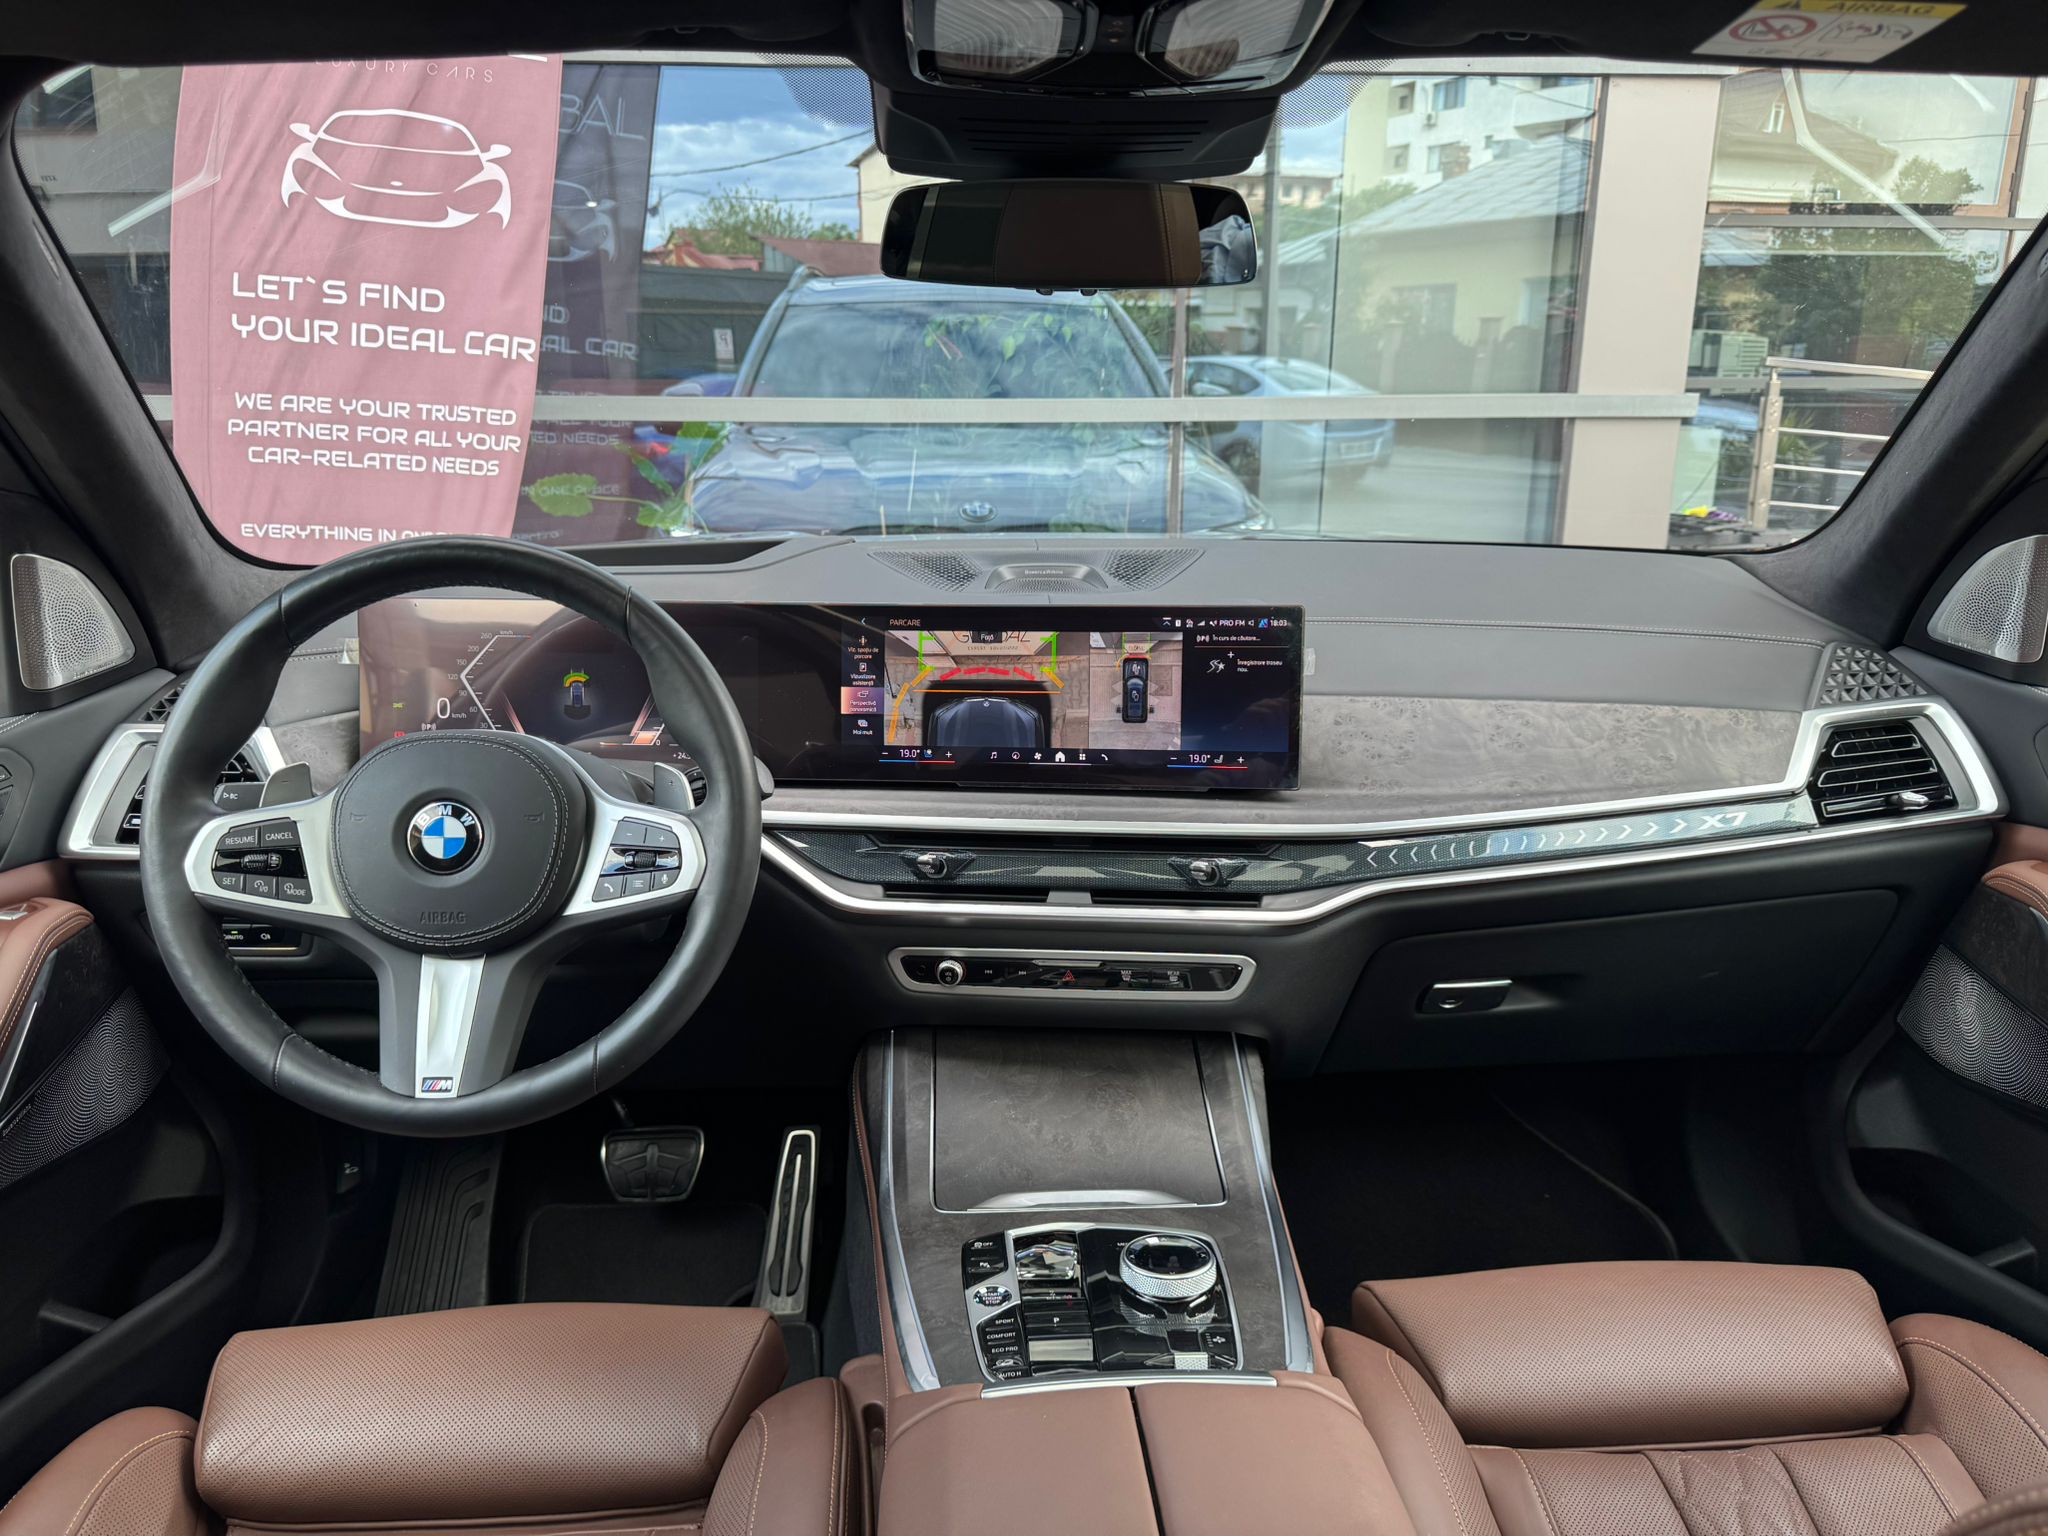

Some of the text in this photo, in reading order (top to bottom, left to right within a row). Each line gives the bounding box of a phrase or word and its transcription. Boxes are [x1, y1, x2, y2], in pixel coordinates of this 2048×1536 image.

[1826, 3, 1936, 15] AIRBAG
[426, 62, 494, 83] CARS
[359, 282, 446, 314] FIND
[231, 313, 537, 362] YOUR IDEAL CAR
[585, 337, 640, 361] CAR
[234, 391, 517, 426] WE ARE YOUR TRUSTED
[227, 418, 522, 453] PARTNER FOR ALL YOUR
[562, 432, 620, 446] NEEDS
[248, 446, 501, 476] CAR-RELATED NEEDS
[240, 523, 374, 542] EVERYTHING
[378, 528, 397, 542] IN
[1219, 619, 1245, 627] PRO FM
[437, 697, 451, 719] 0
[1698, 811, 1748, 831] X7
[225, 835, 255, 845] RESUME
[265, 831, 294, 841] CANCEL
[222, 877, 236, 885] SET
[286, 888, 307, 897] MODE
[419, 911, 467, 925] AIRBAG
[986, 1332, 1016, 1340] COMFORT
